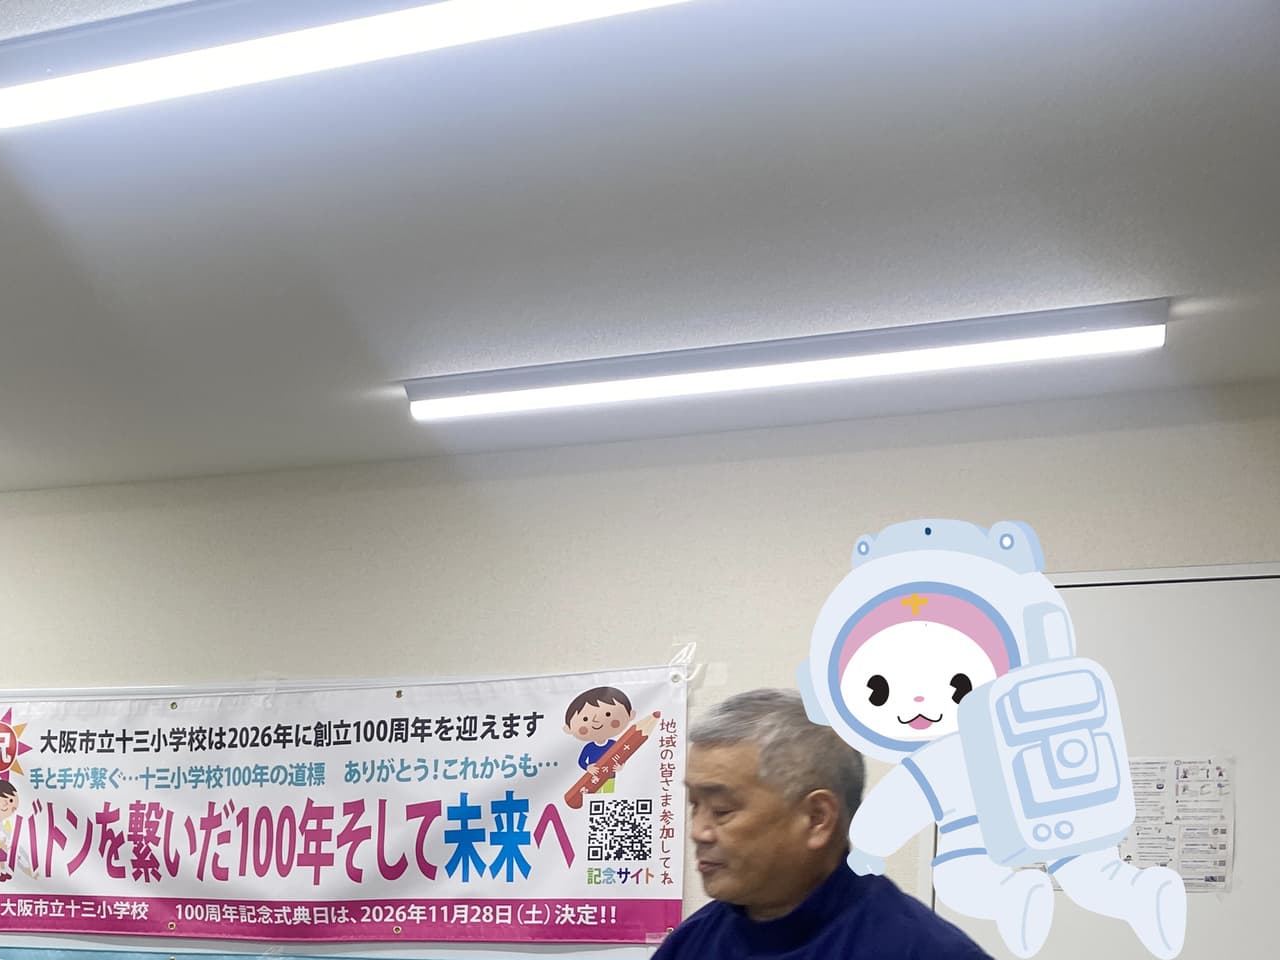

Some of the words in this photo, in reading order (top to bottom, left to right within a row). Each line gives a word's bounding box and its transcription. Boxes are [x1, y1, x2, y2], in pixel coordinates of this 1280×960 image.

[40, 711, 544, 754] 大阪市立十三小学校は2026年に創立100周年を迎えます
[658, 717, 678, 886] 地域の皆さま参加してね
[587, 867, 654, 886] 記念サイト
[0, 899, 149, 921] 大阪市立十三小学校
